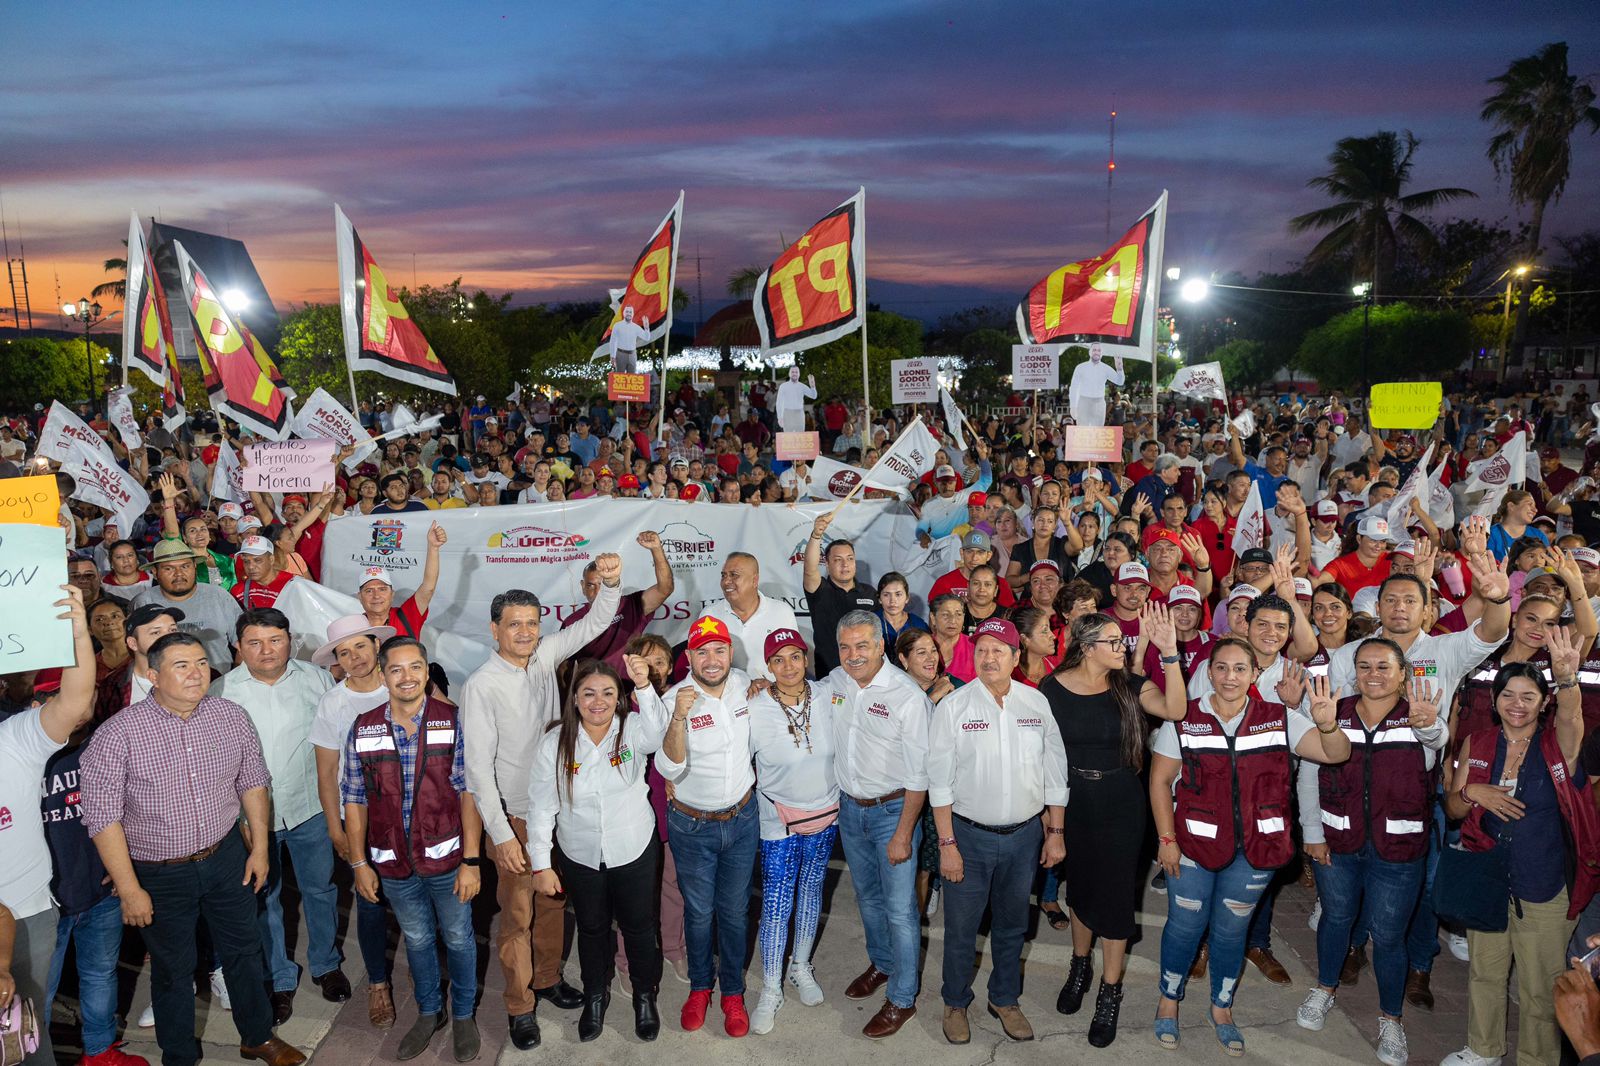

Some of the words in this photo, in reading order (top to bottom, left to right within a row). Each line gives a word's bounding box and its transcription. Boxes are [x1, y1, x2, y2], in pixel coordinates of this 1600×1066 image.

[613, 374, 644, 384] REYES
[333, 408, 352, 430] RAÚL
[314, 408, 357, 445] MORÓN
[254, 450, 316, 467] Hermanos
[95, 461, 122, 487] RAÚL
[258, 473, 311, 490] Morena
[500, 534, 576, 548] MÚGICA
[485, 555, 530, 564] Transformando
[540, 555, 562, 565] Múgica
[563, 551, 590, 562] saludable
[774, 632, 794, 642] RM
[868, 707, 889, 717] MORÓN
[872, 702, 887, 711] RAÚL
[690, 714, 712, 724] REYES
[1182, 720, 1212, 728] CLAUDIA
[692, 721, 714, 730] GALINDO
[1250, 720, 1282, 732] morena
